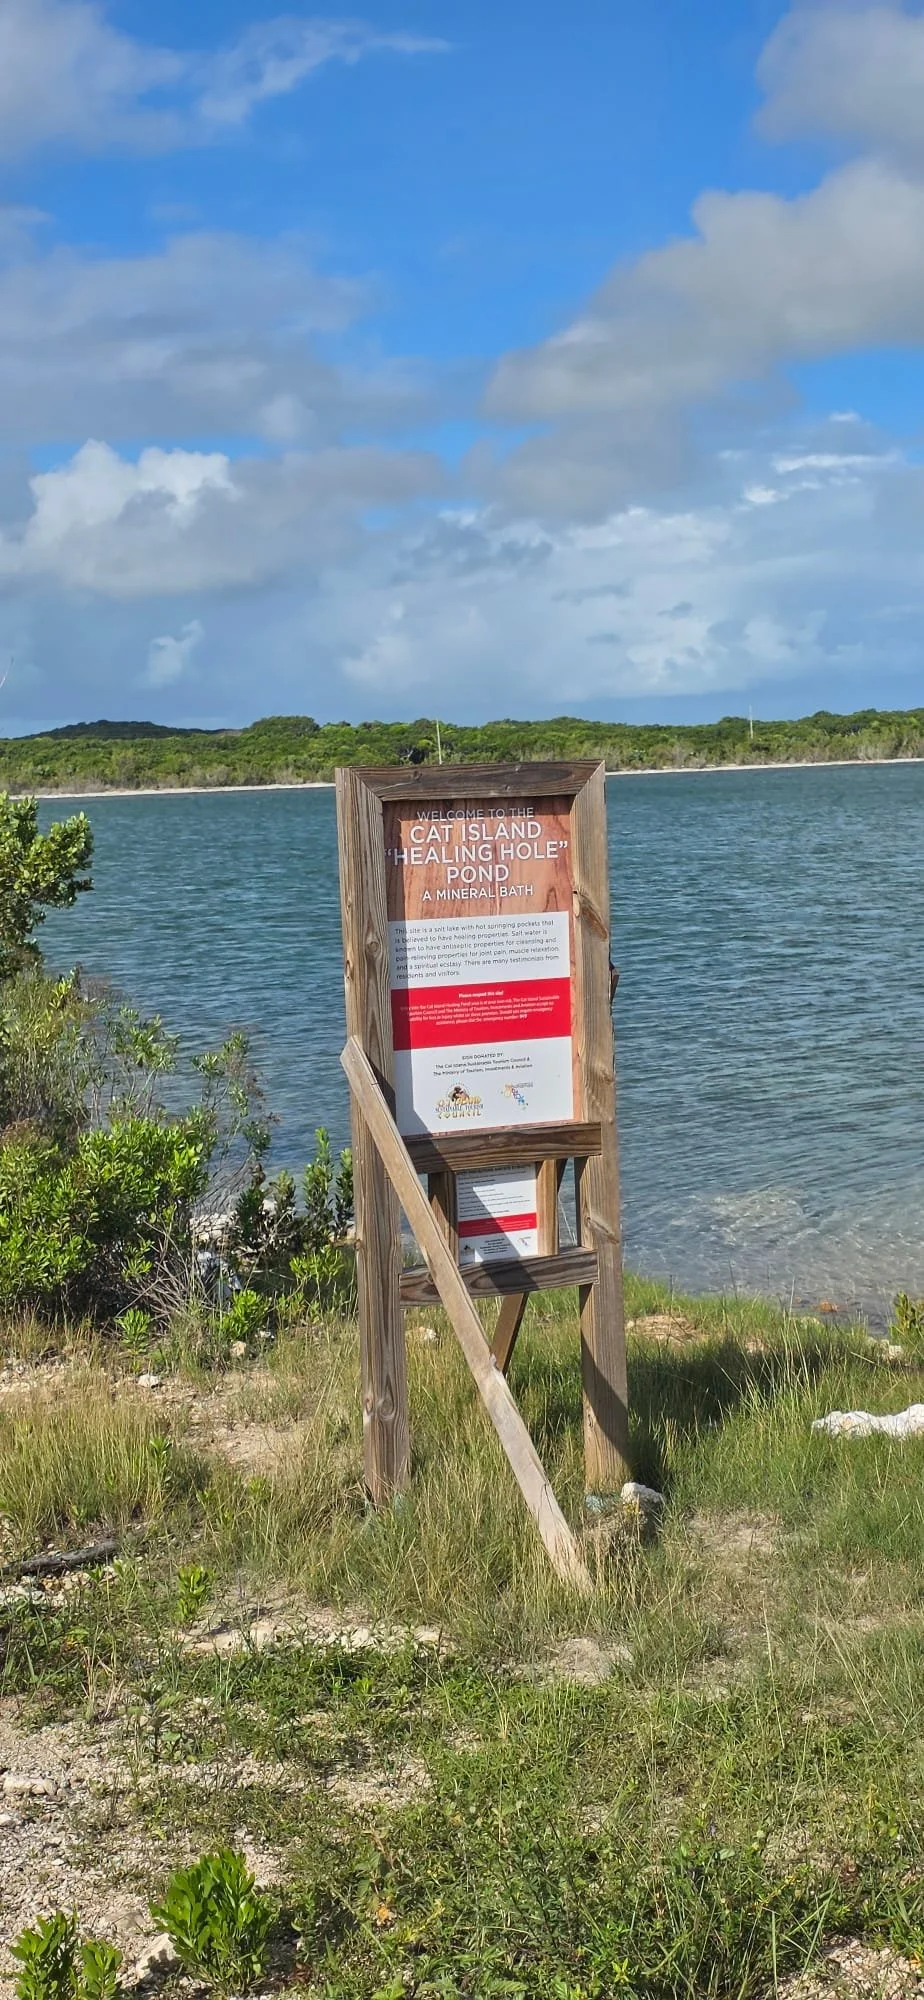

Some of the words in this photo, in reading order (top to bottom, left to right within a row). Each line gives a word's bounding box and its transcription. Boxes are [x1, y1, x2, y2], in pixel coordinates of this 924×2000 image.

[417, 809, 485, 822] WELCOME
[488, 809, 505, 819] TO
[510, 807, 534, 818] THE
[410, 825, 452, 843] CAT
[462, 821, 541, 841] ISLAND
[447, 864, 509, 884] POND
[422, 891, 432, 901] A
[437, 888, 495, 900] MINERAL
[500, 885, 533, 896] BATH
